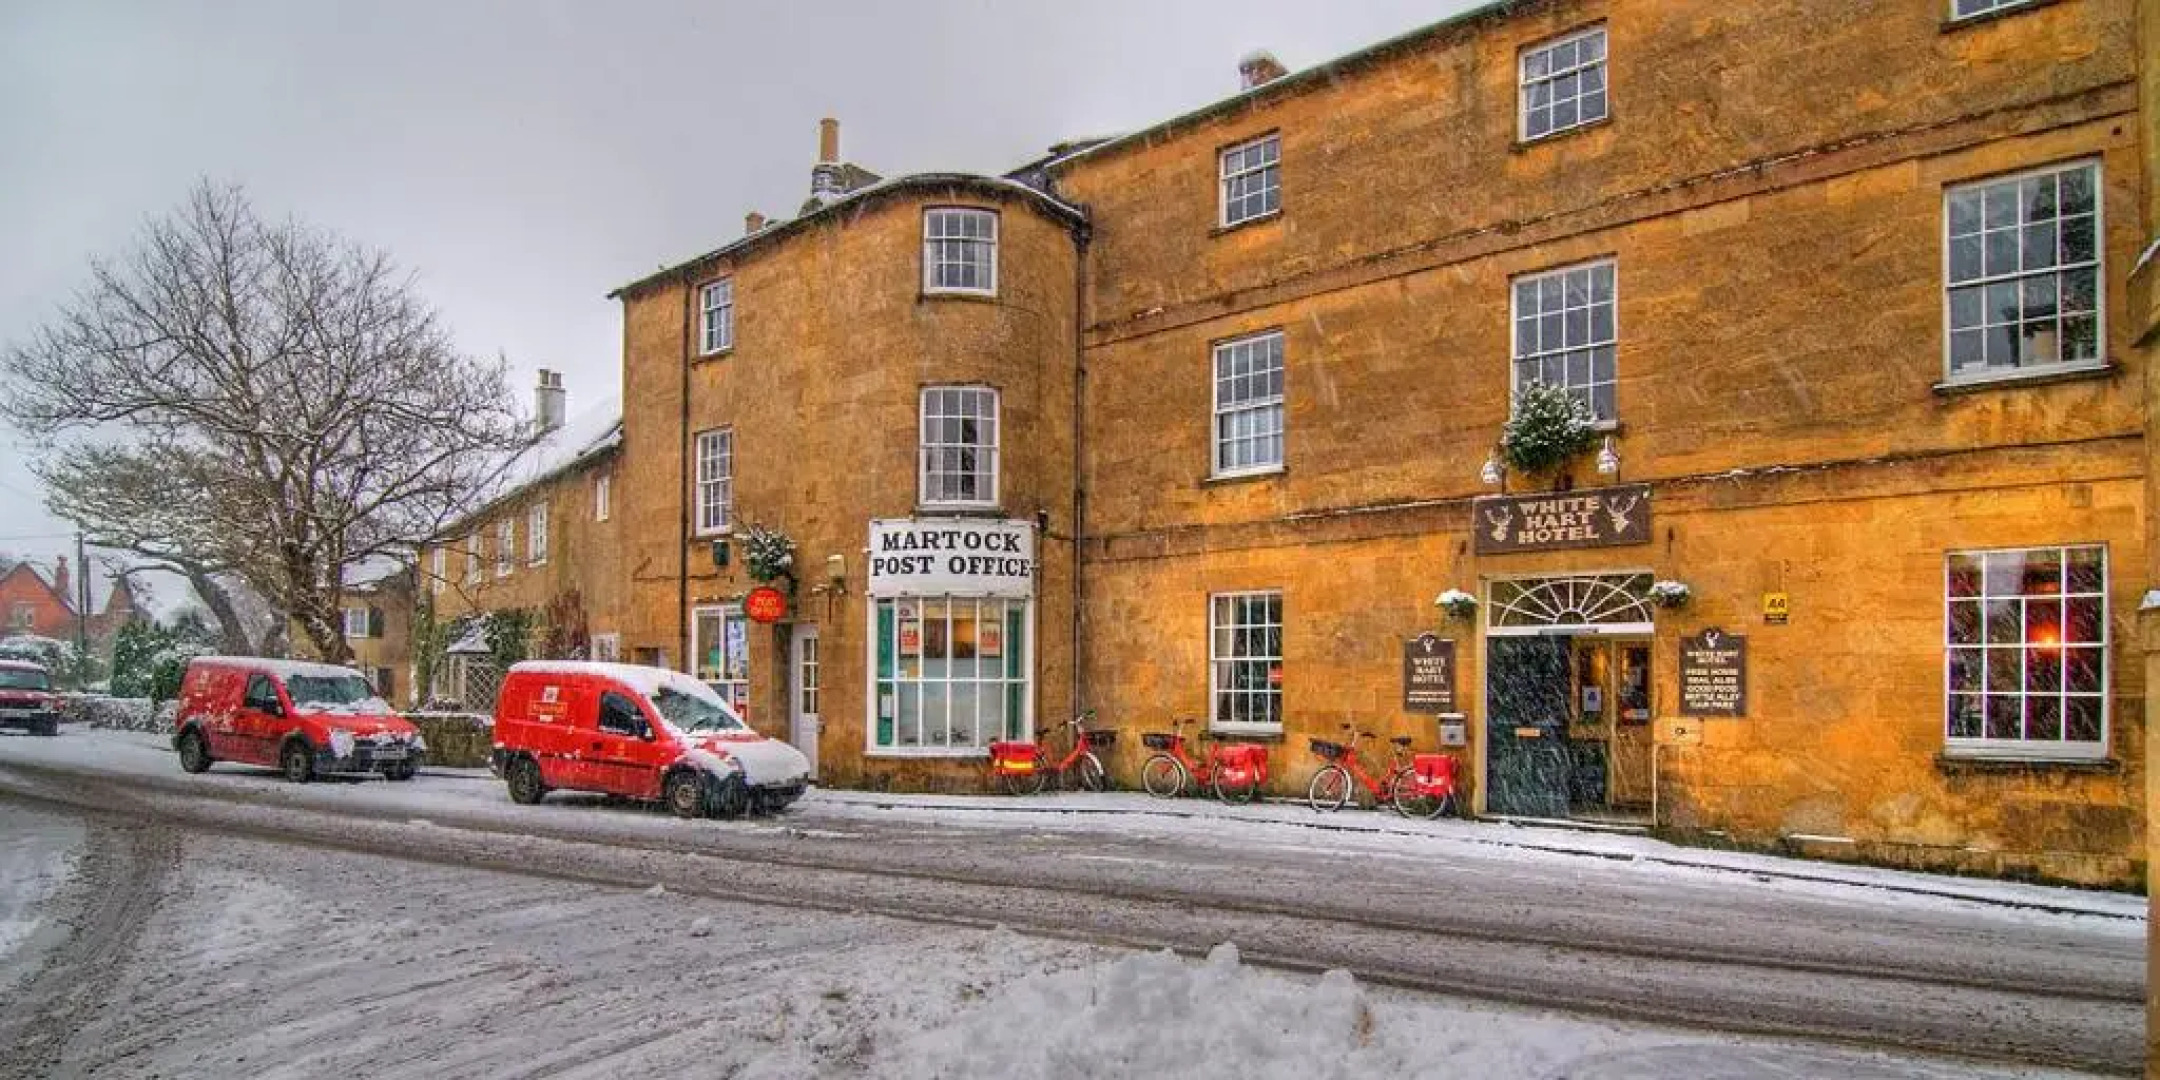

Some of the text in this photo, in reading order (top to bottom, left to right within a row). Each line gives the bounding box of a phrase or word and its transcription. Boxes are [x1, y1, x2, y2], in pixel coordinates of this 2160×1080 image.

[1518, 497, 1600, 515] WHITE
[1526, 512, 1591, 528] HART
[881, 531, 1022, 552] MARTOCK
[1518, 525, 1600, 544] HOTEL
[871, 556, 1031, 577] POST OFFICE
[1412, 657, 1446, 667] WHITE
[1412, 674, 1446, 684] HOTEL
